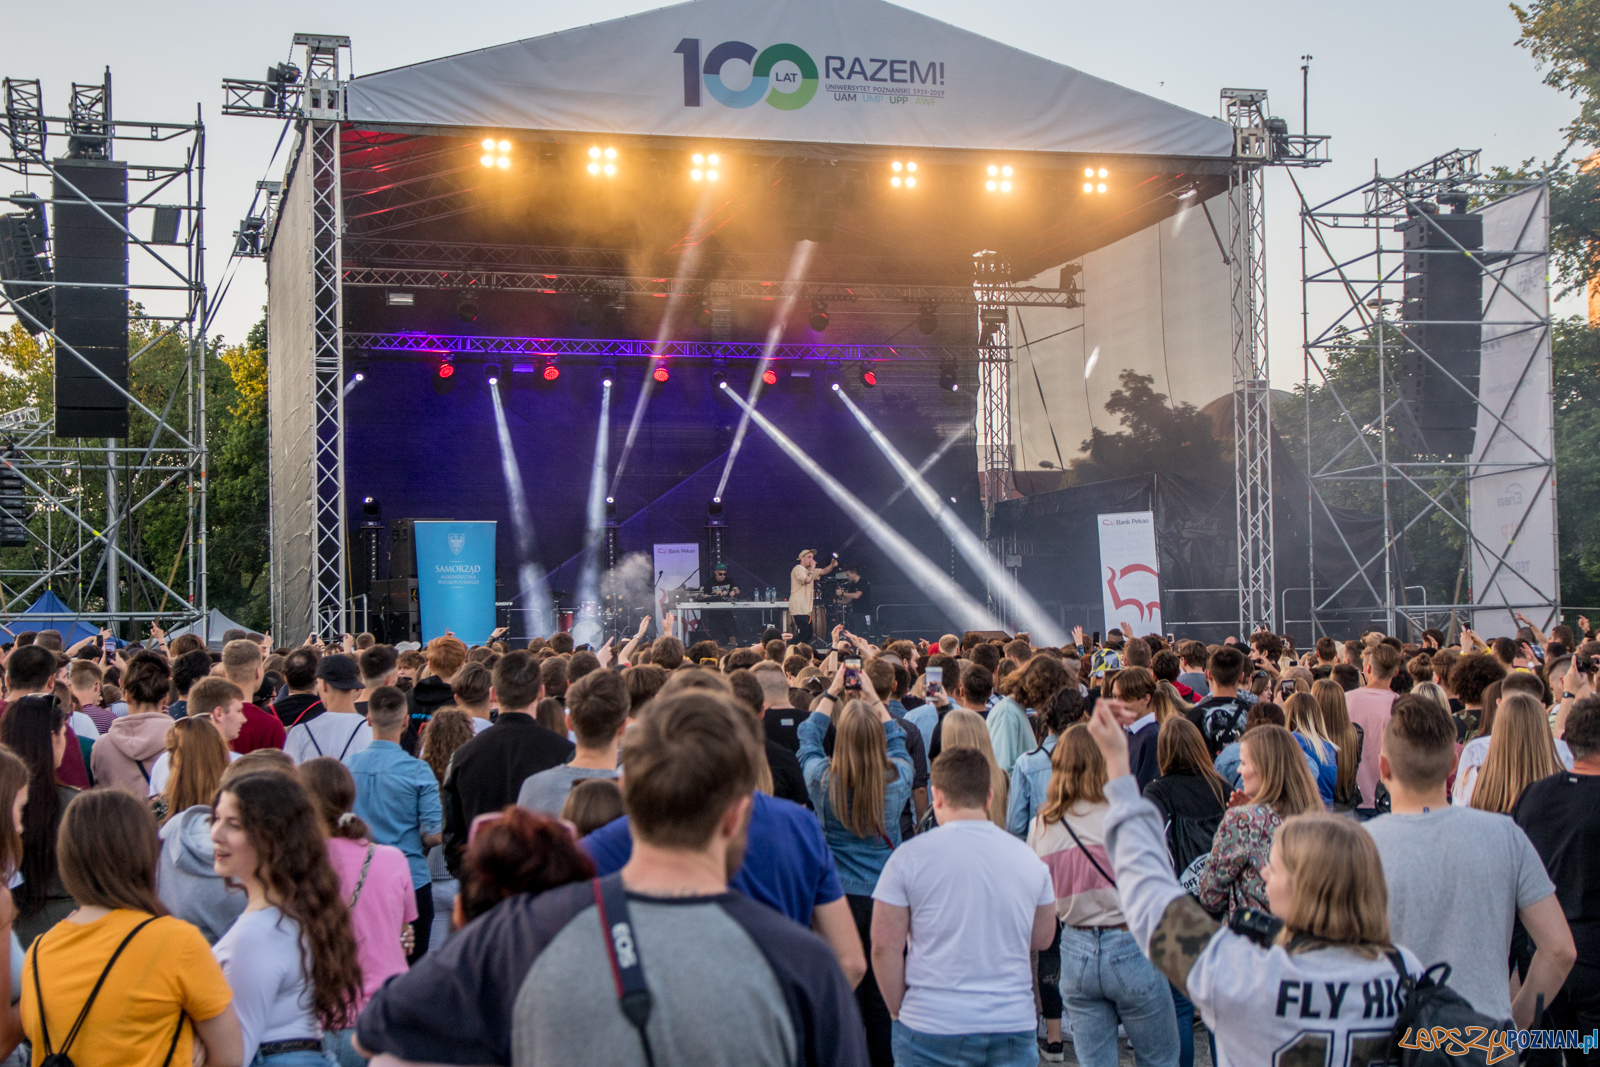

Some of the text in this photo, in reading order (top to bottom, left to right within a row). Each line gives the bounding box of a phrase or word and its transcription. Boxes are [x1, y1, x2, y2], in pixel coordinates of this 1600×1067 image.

[673, 38, 819, 111] 100
[775, 72, 798, 83] LAT
[825, 55, 945, 85] RAZEM!
[825, 83, 945, 96] UNIWERSYTET POZNAŃSKI 1919-2019
[833, 93, 936, 106] UAM UMP UPP AWF
[435, 564, 481, 574] SAMORZĄD
[611, 921, 638, 969] EOS
[1275, 980, 1349, 1019] FLY
